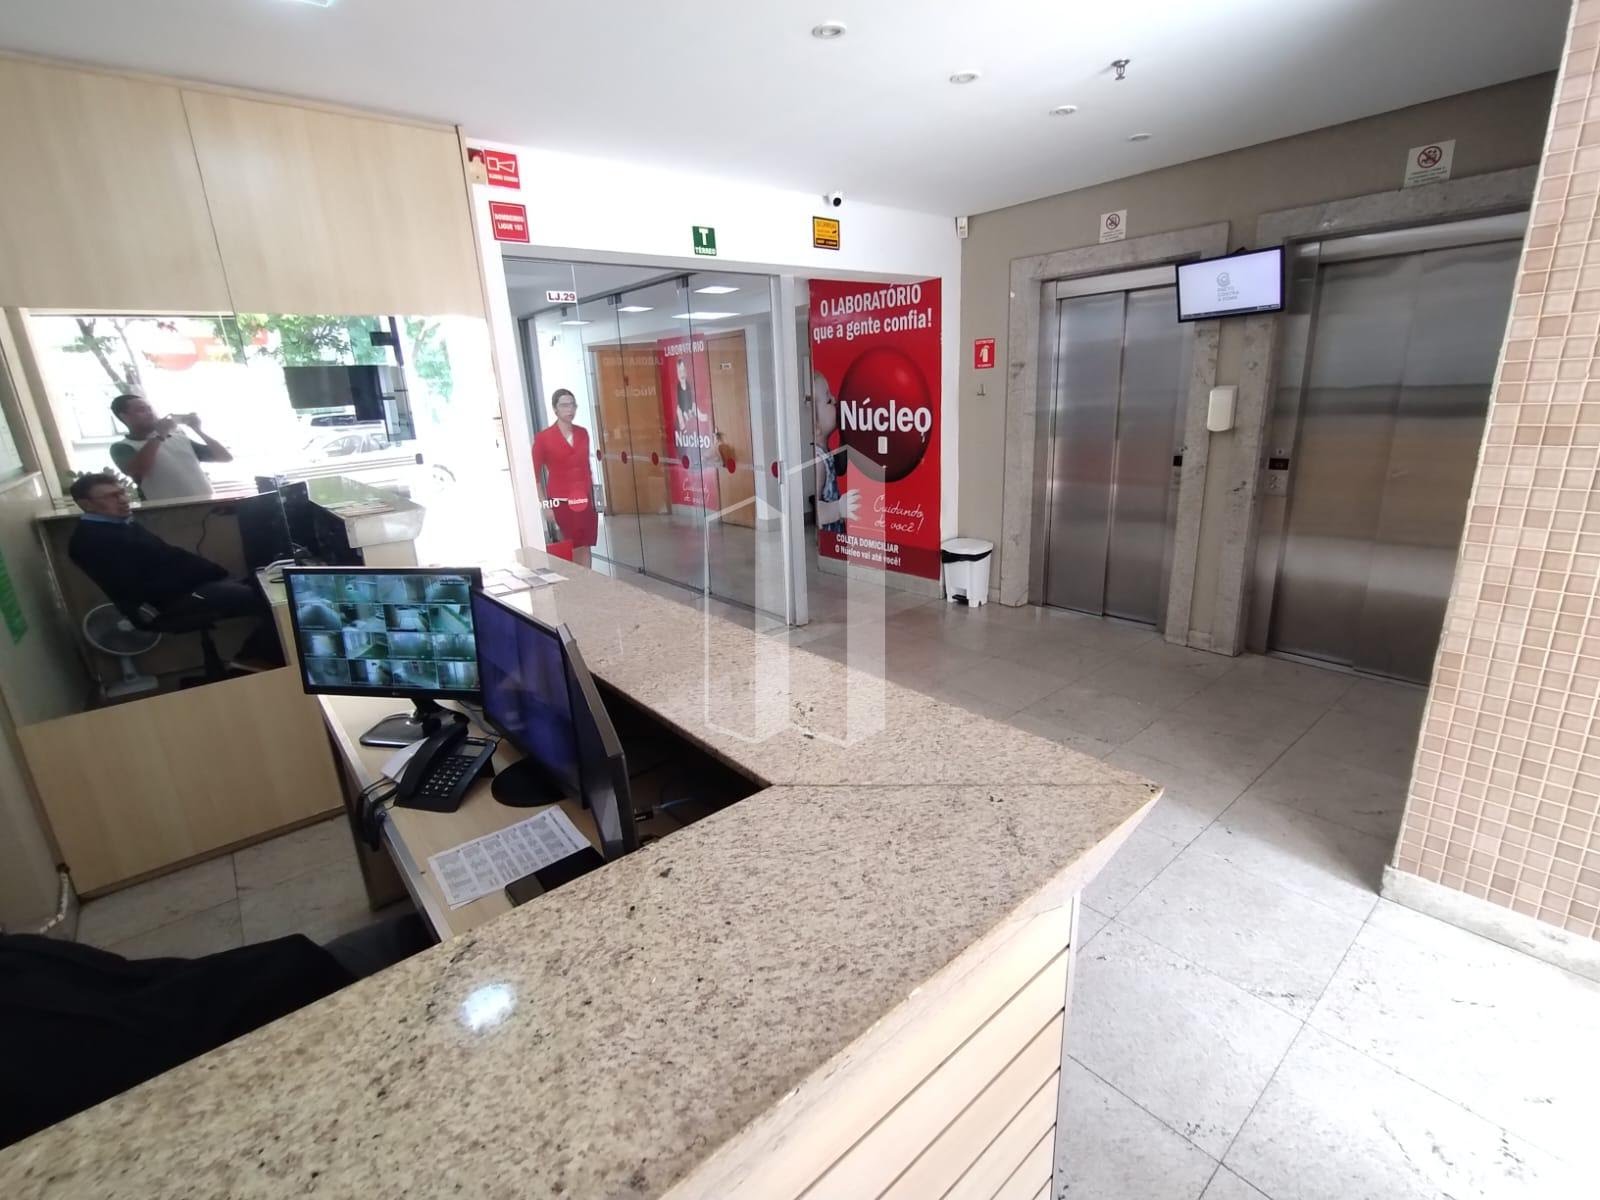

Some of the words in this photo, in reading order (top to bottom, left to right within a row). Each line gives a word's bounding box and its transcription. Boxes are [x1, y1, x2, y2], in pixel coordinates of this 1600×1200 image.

[698, 228, 708, 245] T
[820, 299, 829, 317] O
[831, 282, 922, 316] LABORATÓRIO
[813, 325, 834, 344] que
[836, 326, 843, 338] a
[846, 318, 880, 340] gente
[883, 308, 932, 333] confia!
[840, 397, 932, 433] Núcleo
[674, 429, 711, 449] Núcleo
[836, 534, 859, 547] COLETA
[859, 537, 899, 553] DOMICILIAR
[840, 546, 861, 558] Núcleo
